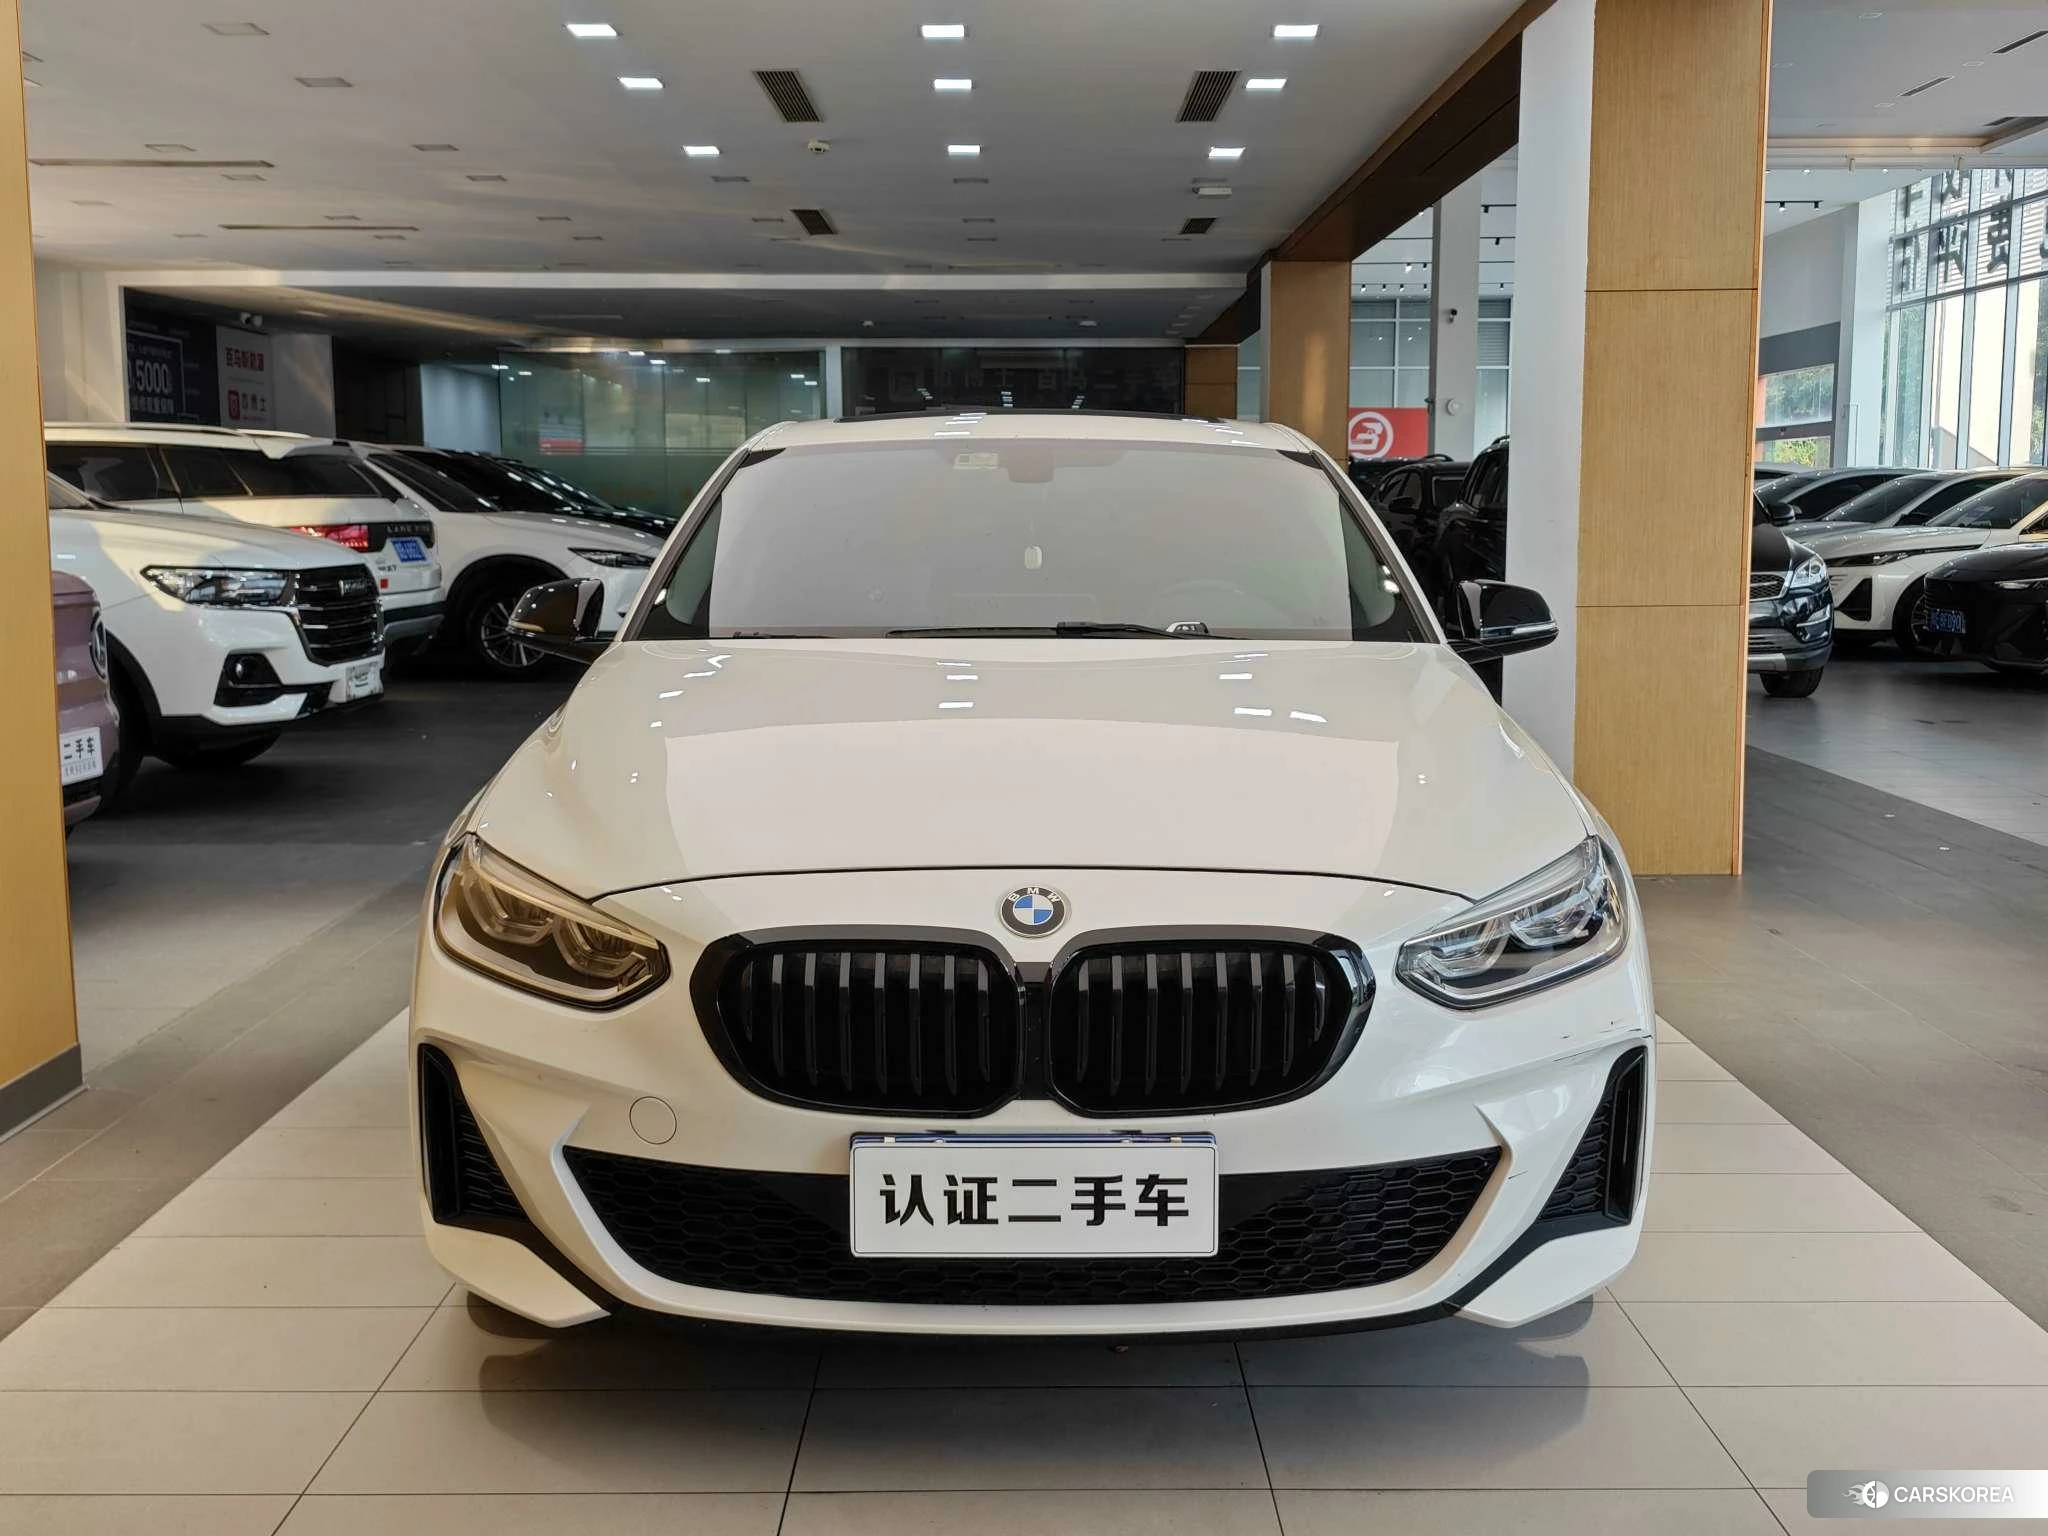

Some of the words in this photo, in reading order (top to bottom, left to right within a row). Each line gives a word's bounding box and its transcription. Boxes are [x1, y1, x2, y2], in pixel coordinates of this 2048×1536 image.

[64, 735, 96, 760] 二手车
[1008, 887, 1061, 902] BMW
[880, 1174, 1189, 1226] 认证二手车
